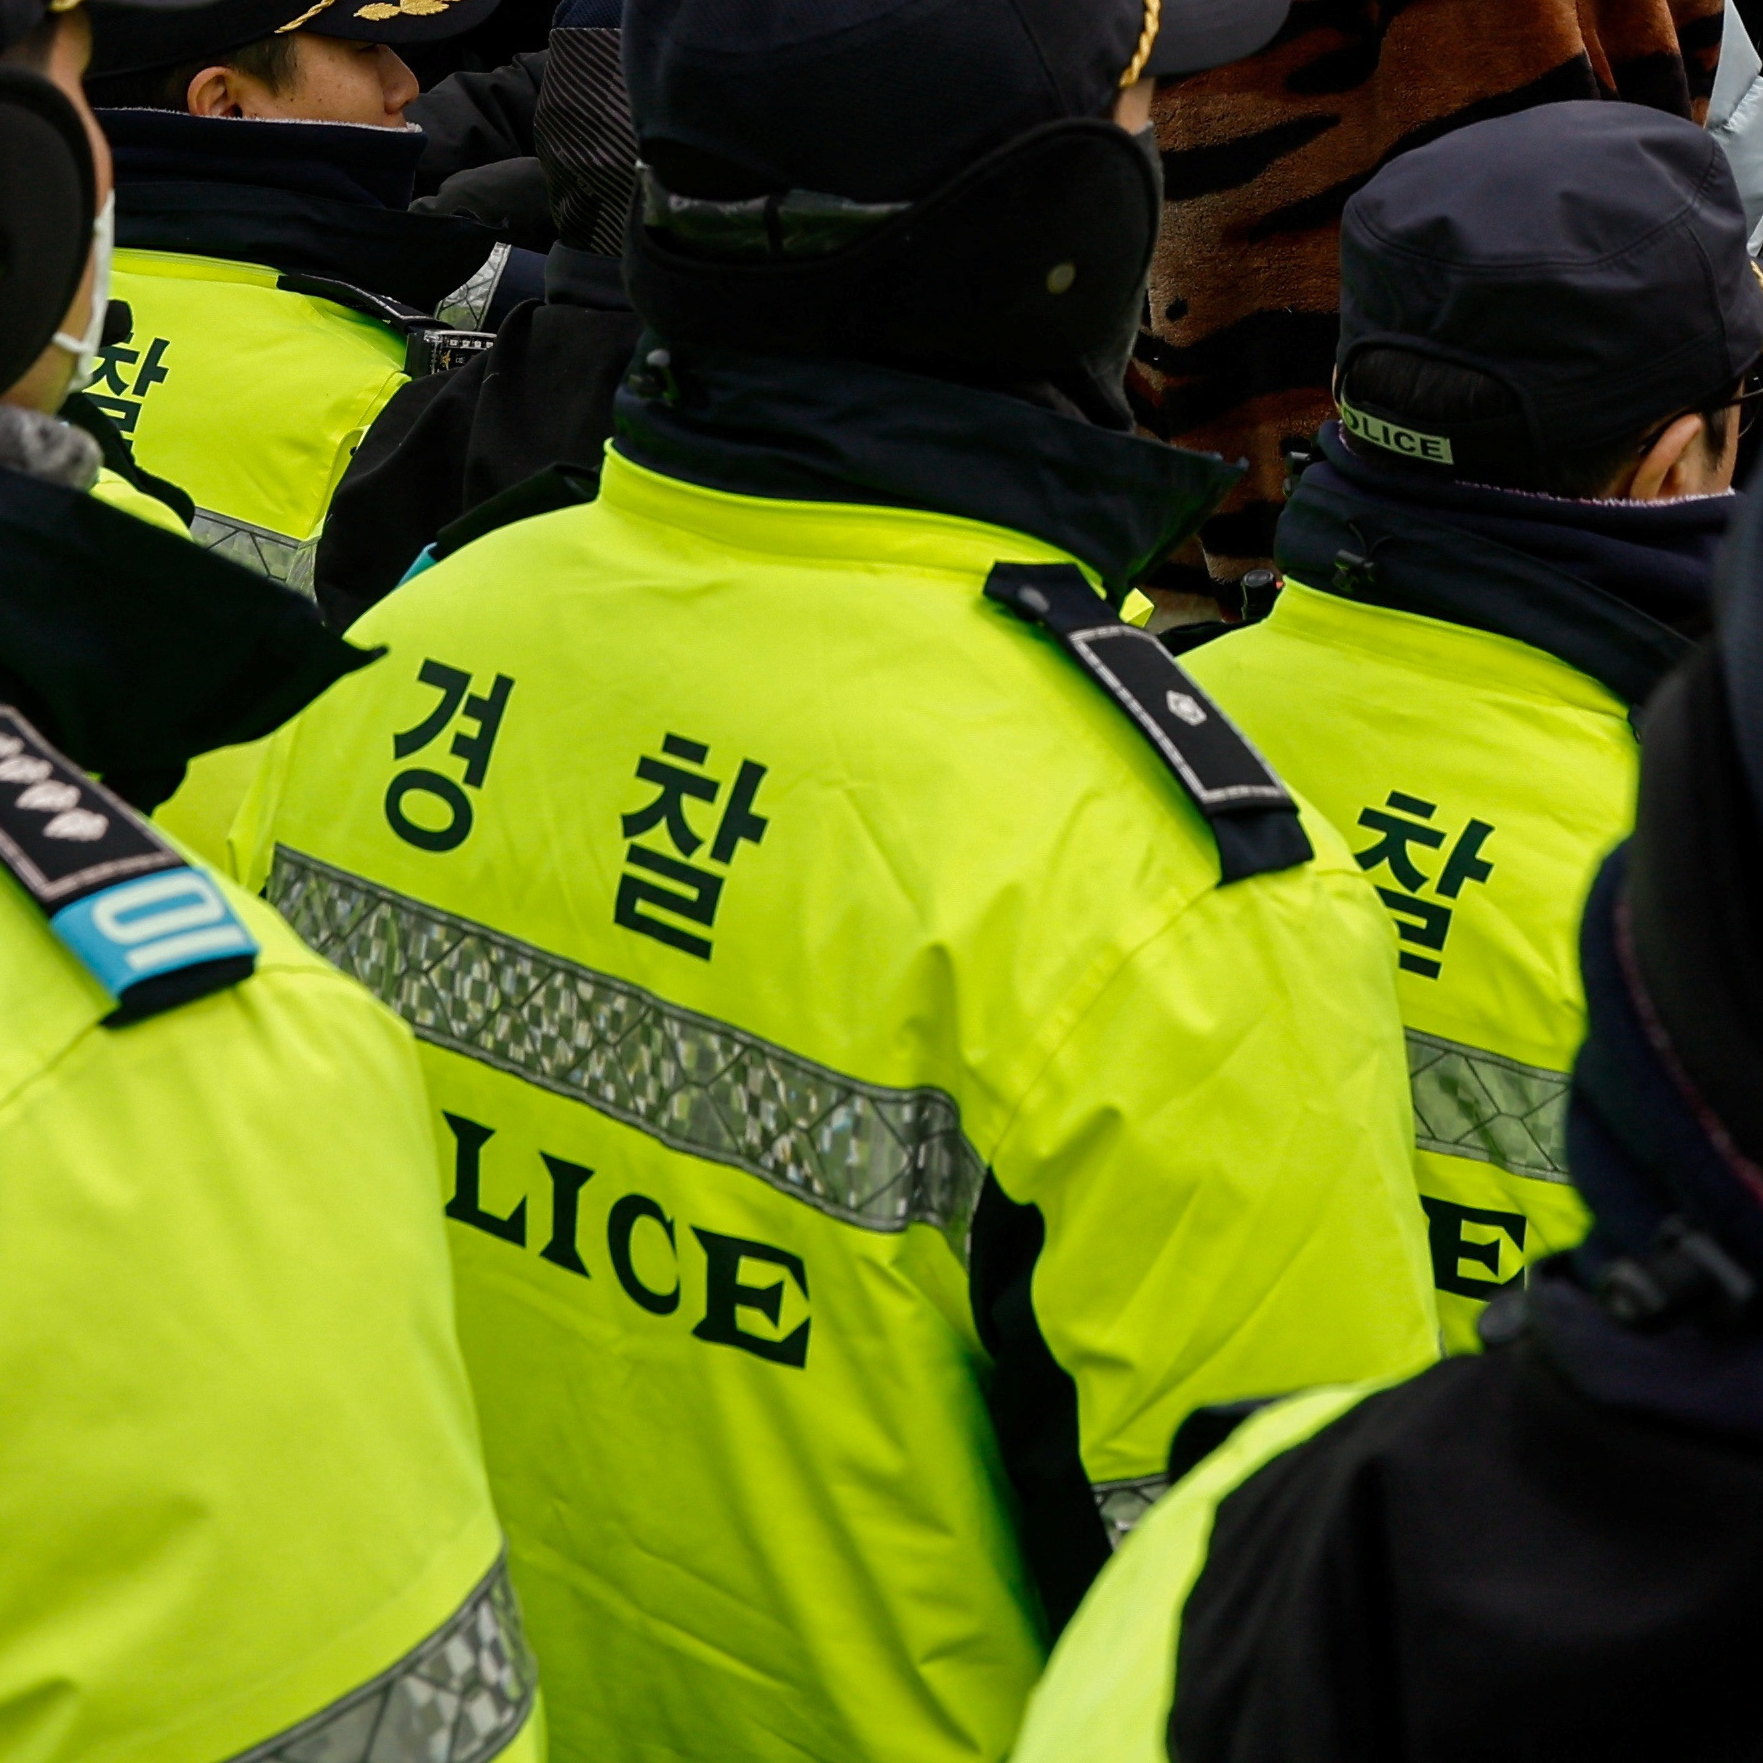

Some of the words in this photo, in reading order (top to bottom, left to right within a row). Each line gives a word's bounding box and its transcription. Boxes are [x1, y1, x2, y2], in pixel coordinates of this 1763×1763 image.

[1342, 406, 1444, 460] OLICE
[1353, 789, 1496, 981] 찰
[441, 1109, 812, 1371] LICE
